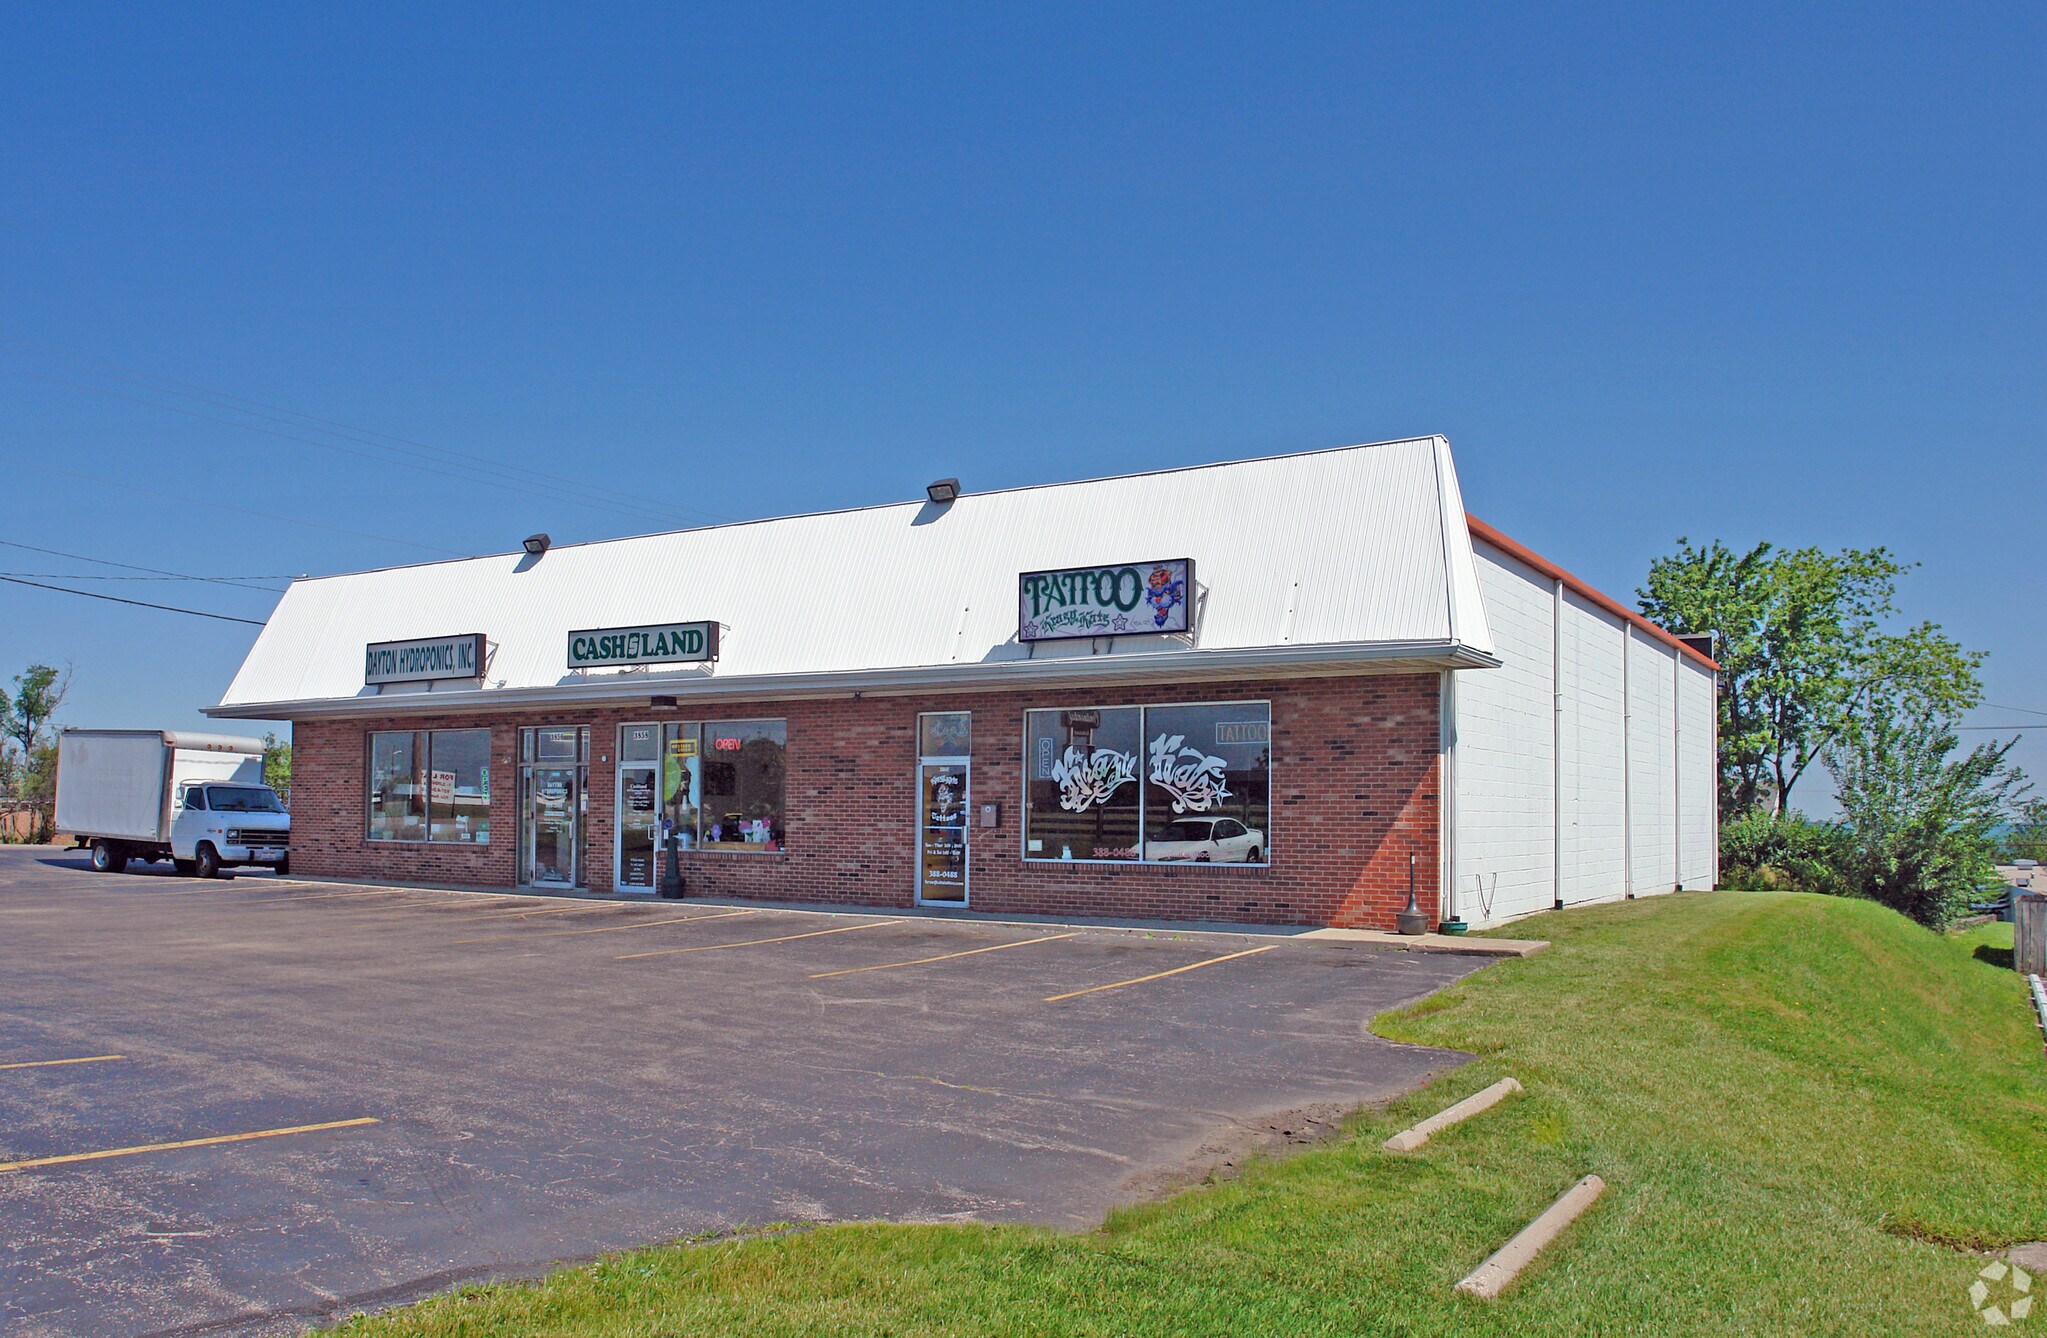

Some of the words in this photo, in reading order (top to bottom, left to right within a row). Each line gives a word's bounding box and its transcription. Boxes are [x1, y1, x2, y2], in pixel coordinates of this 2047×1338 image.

[1024, 567, 1144, 618] TATTOO
[367, 649, 398, 676] DAYTON
[399, 644, 456, 675] HYDROPONICS,
[458, 642, 475, 669] INC.
[714, 738, 741, 750] OPEN
[1219, 724, 1267, 742] TATTOO
[1041, 740, 1050, 776] OPEN
